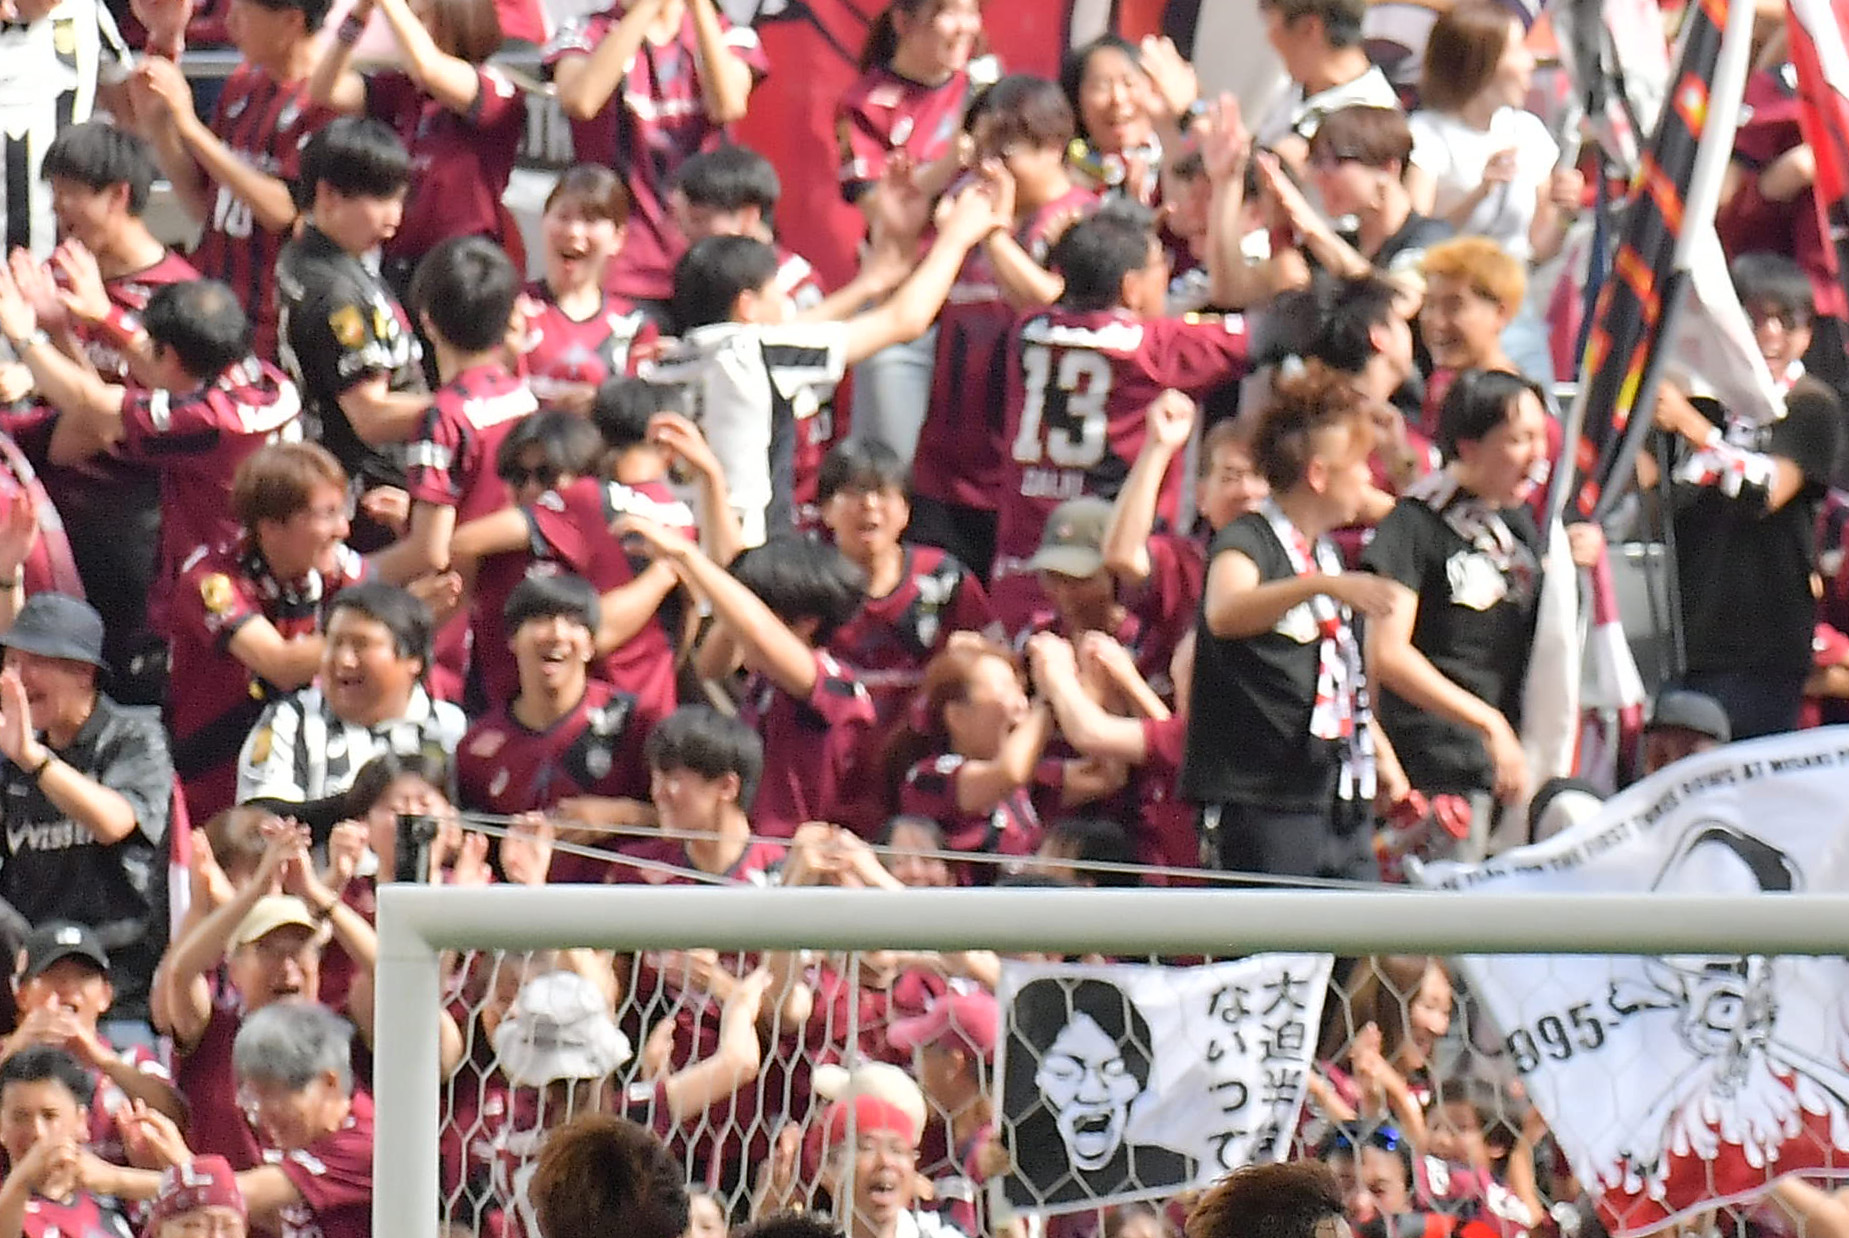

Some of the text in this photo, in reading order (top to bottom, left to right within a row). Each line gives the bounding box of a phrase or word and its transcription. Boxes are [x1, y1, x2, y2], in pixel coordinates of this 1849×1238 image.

[1011, 348, 1112, 468] 13
[1206, 984, 1251, 1171] ないって
